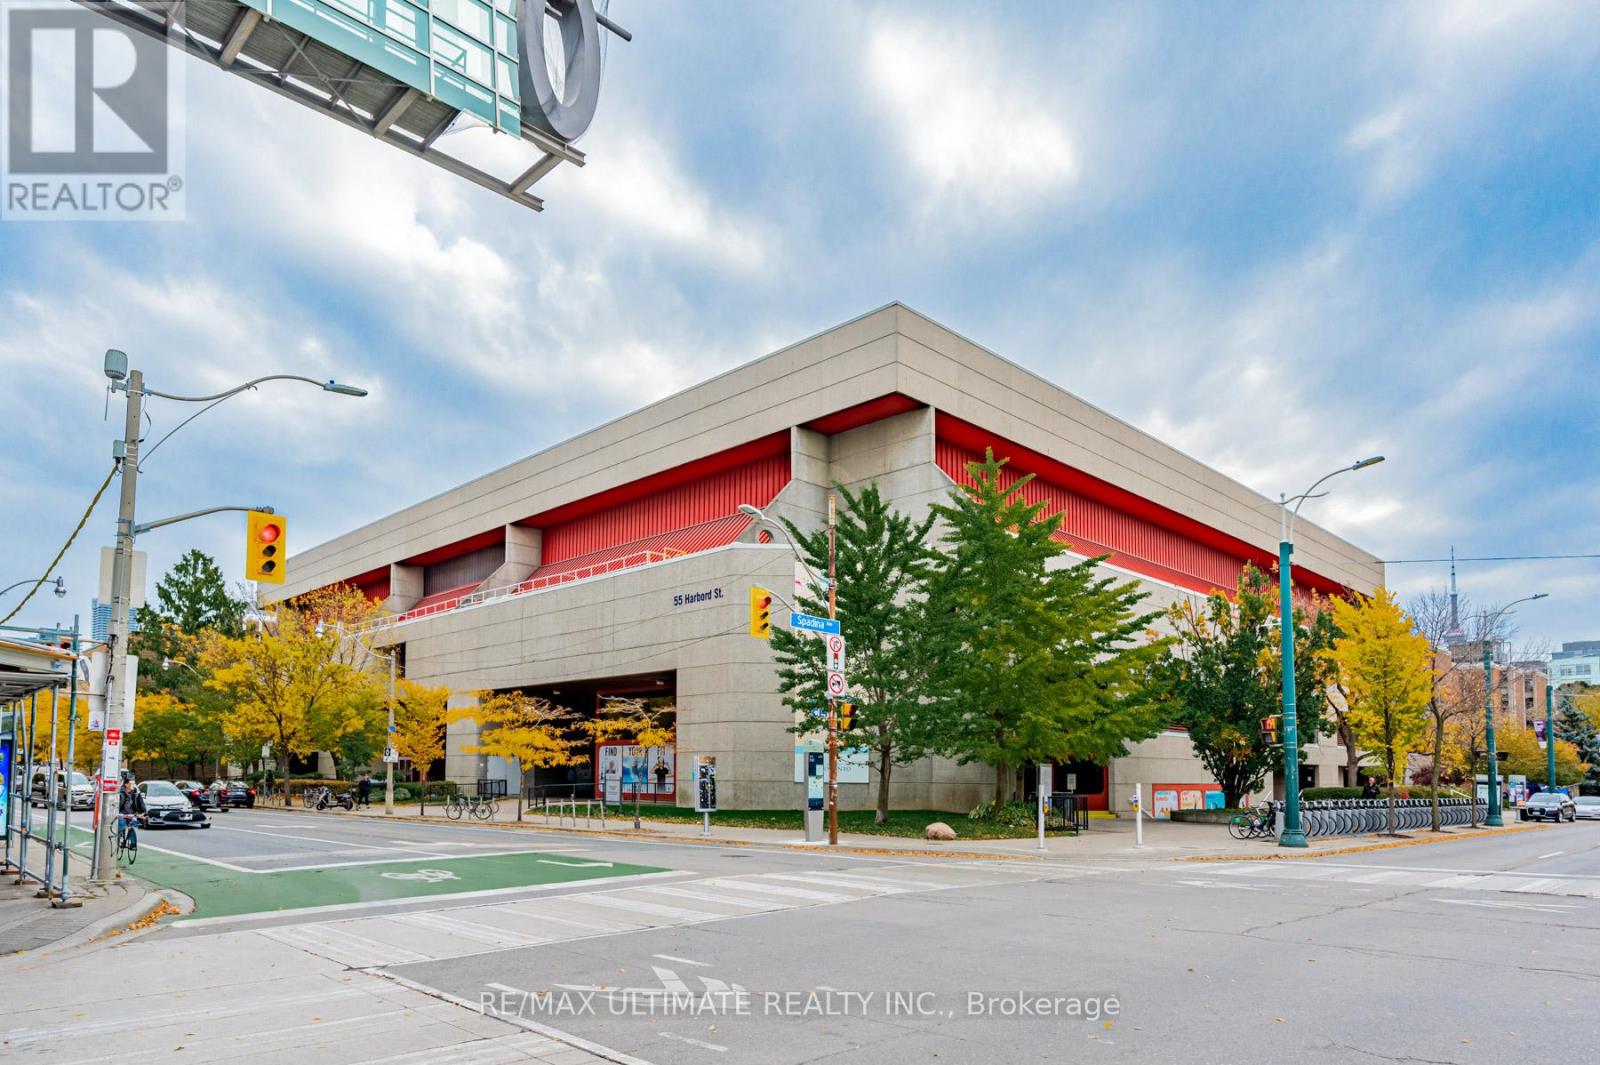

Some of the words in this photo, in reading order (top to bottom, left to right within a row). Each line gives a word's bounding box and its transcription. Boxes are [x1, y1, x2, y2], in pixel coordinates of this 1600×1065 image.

[673, 595, 683, 606] 55
[685, 590, 712, 604] Harbord
[714, 588, 724, 598] St.
[797, 615, 824, 629] Spadina
[605, 747, 617, 756] FIND
